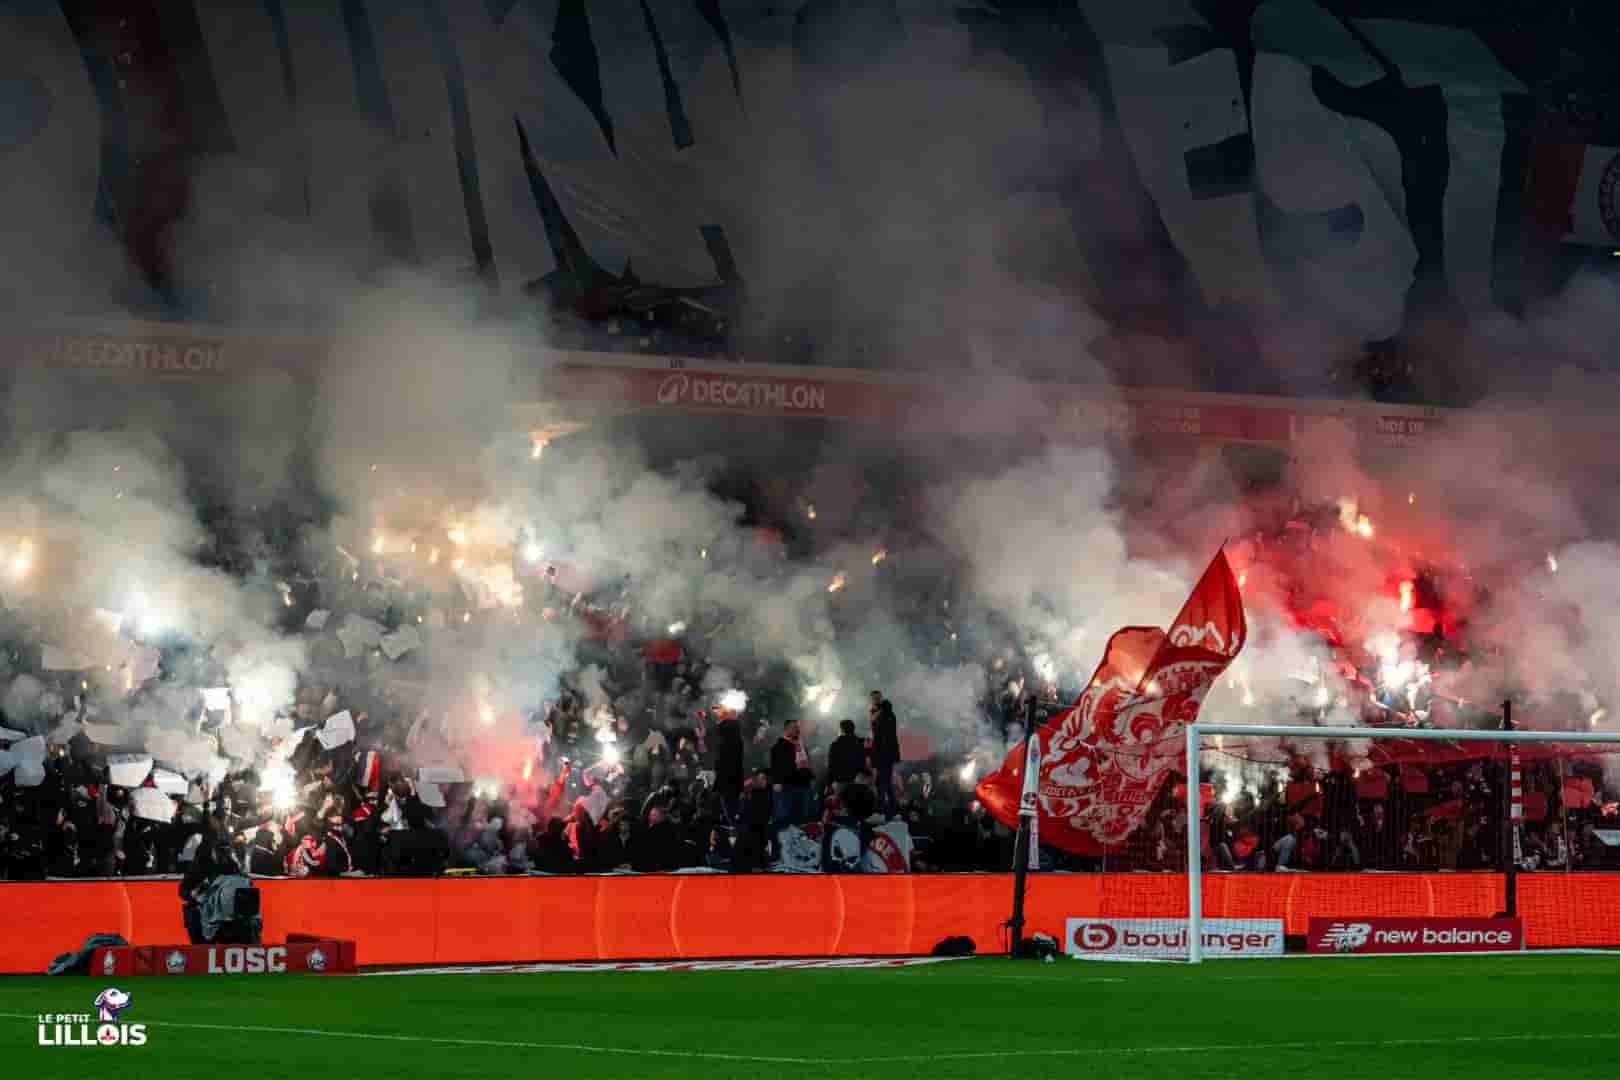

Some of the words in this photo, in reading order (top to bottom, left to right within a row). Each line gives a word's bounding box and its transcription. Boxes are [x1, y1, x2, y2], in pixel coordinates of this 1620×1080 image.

[694, 379, 826, 410] DECATHLON
[1123, 929, 1276, 951] boulnger
[1374, 929, 1418, 944] new
[1422, 927, 1512, 944] balance
[207, 947, 287, 974] LOSC
